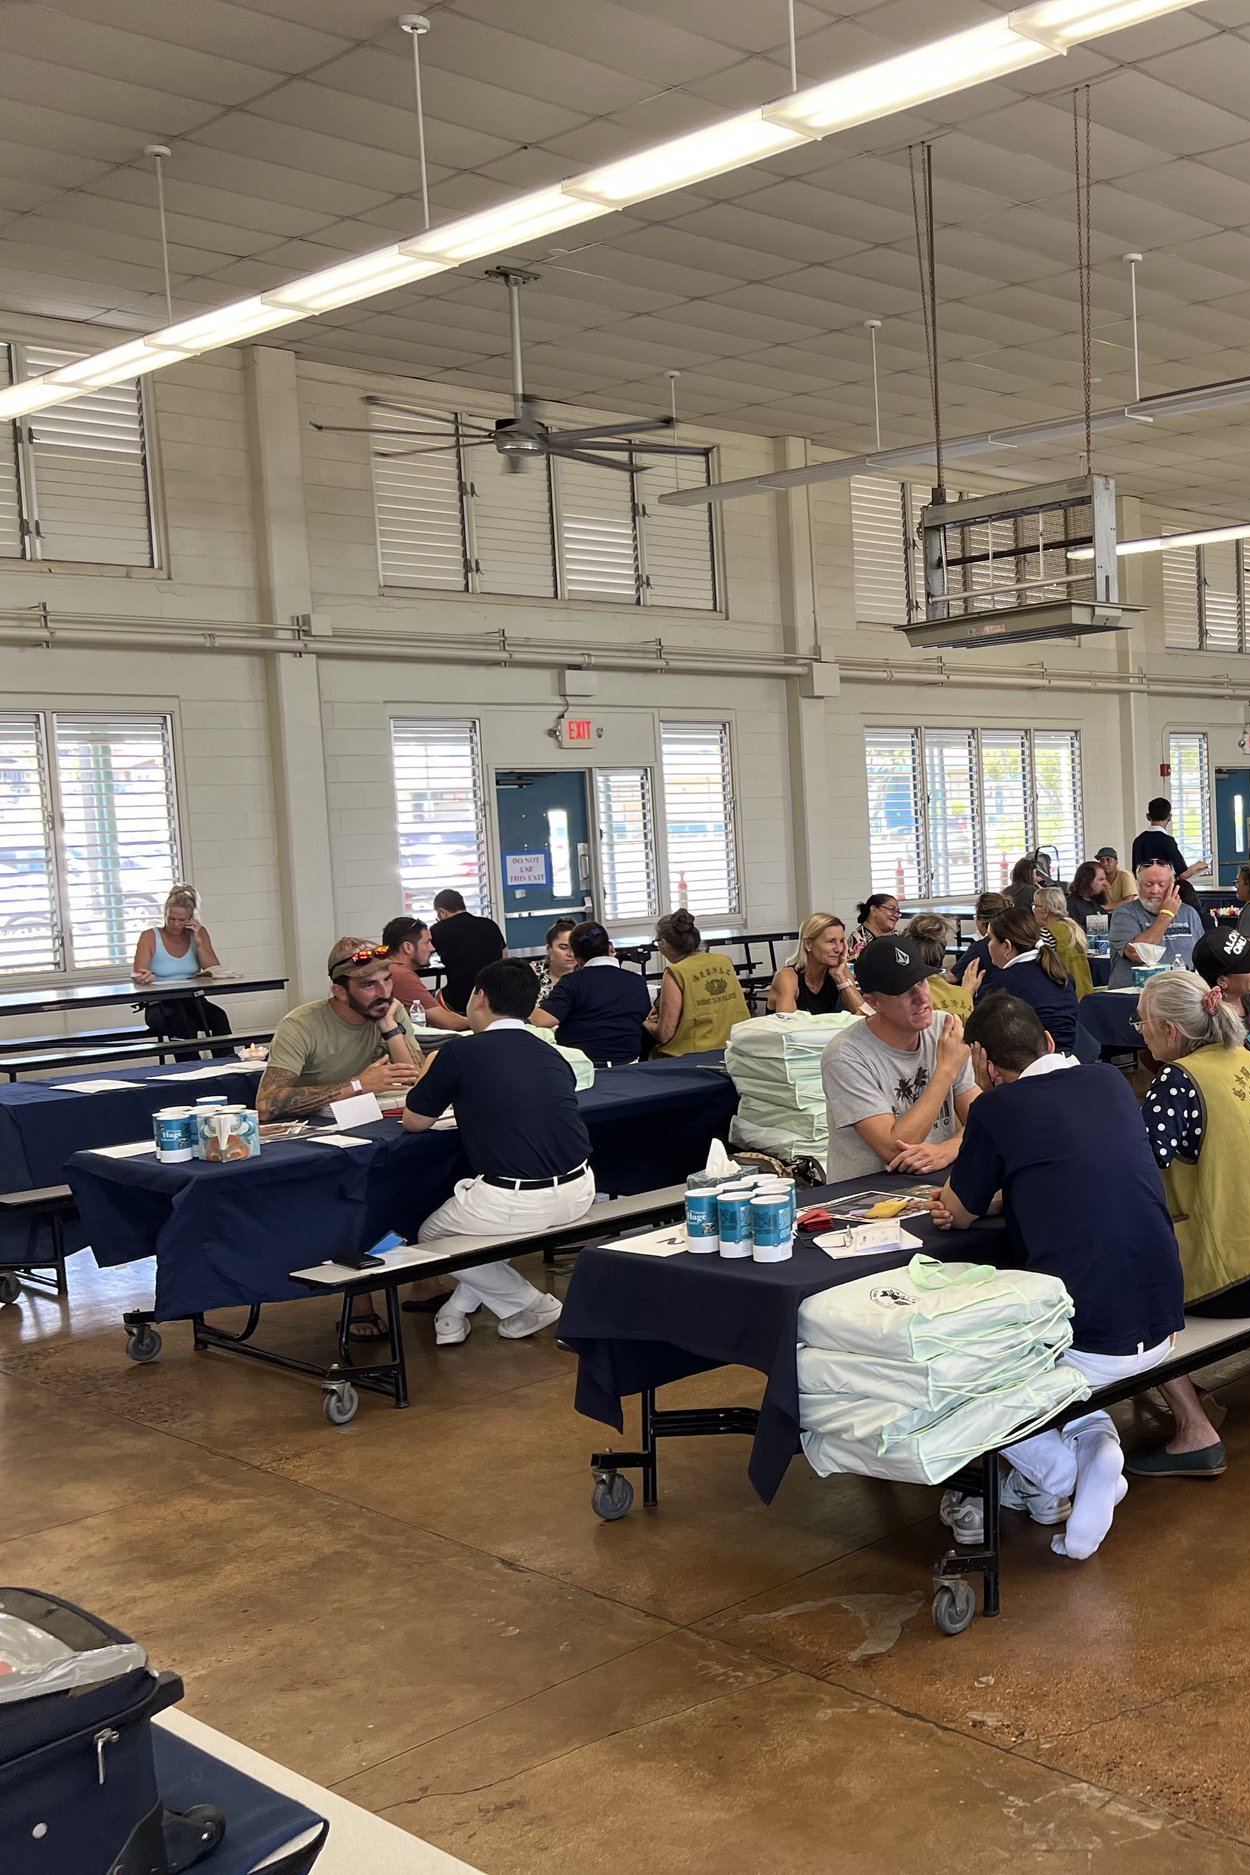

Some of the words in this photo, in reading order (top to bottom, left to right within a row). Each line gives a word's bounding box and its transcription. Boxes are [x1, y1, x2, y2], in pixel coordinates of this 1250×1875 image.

[568, 720, 592, 740] EXIT
[162, 1131, 182, 1139] Huge
[687, 1213, 706, 1223] Huge
